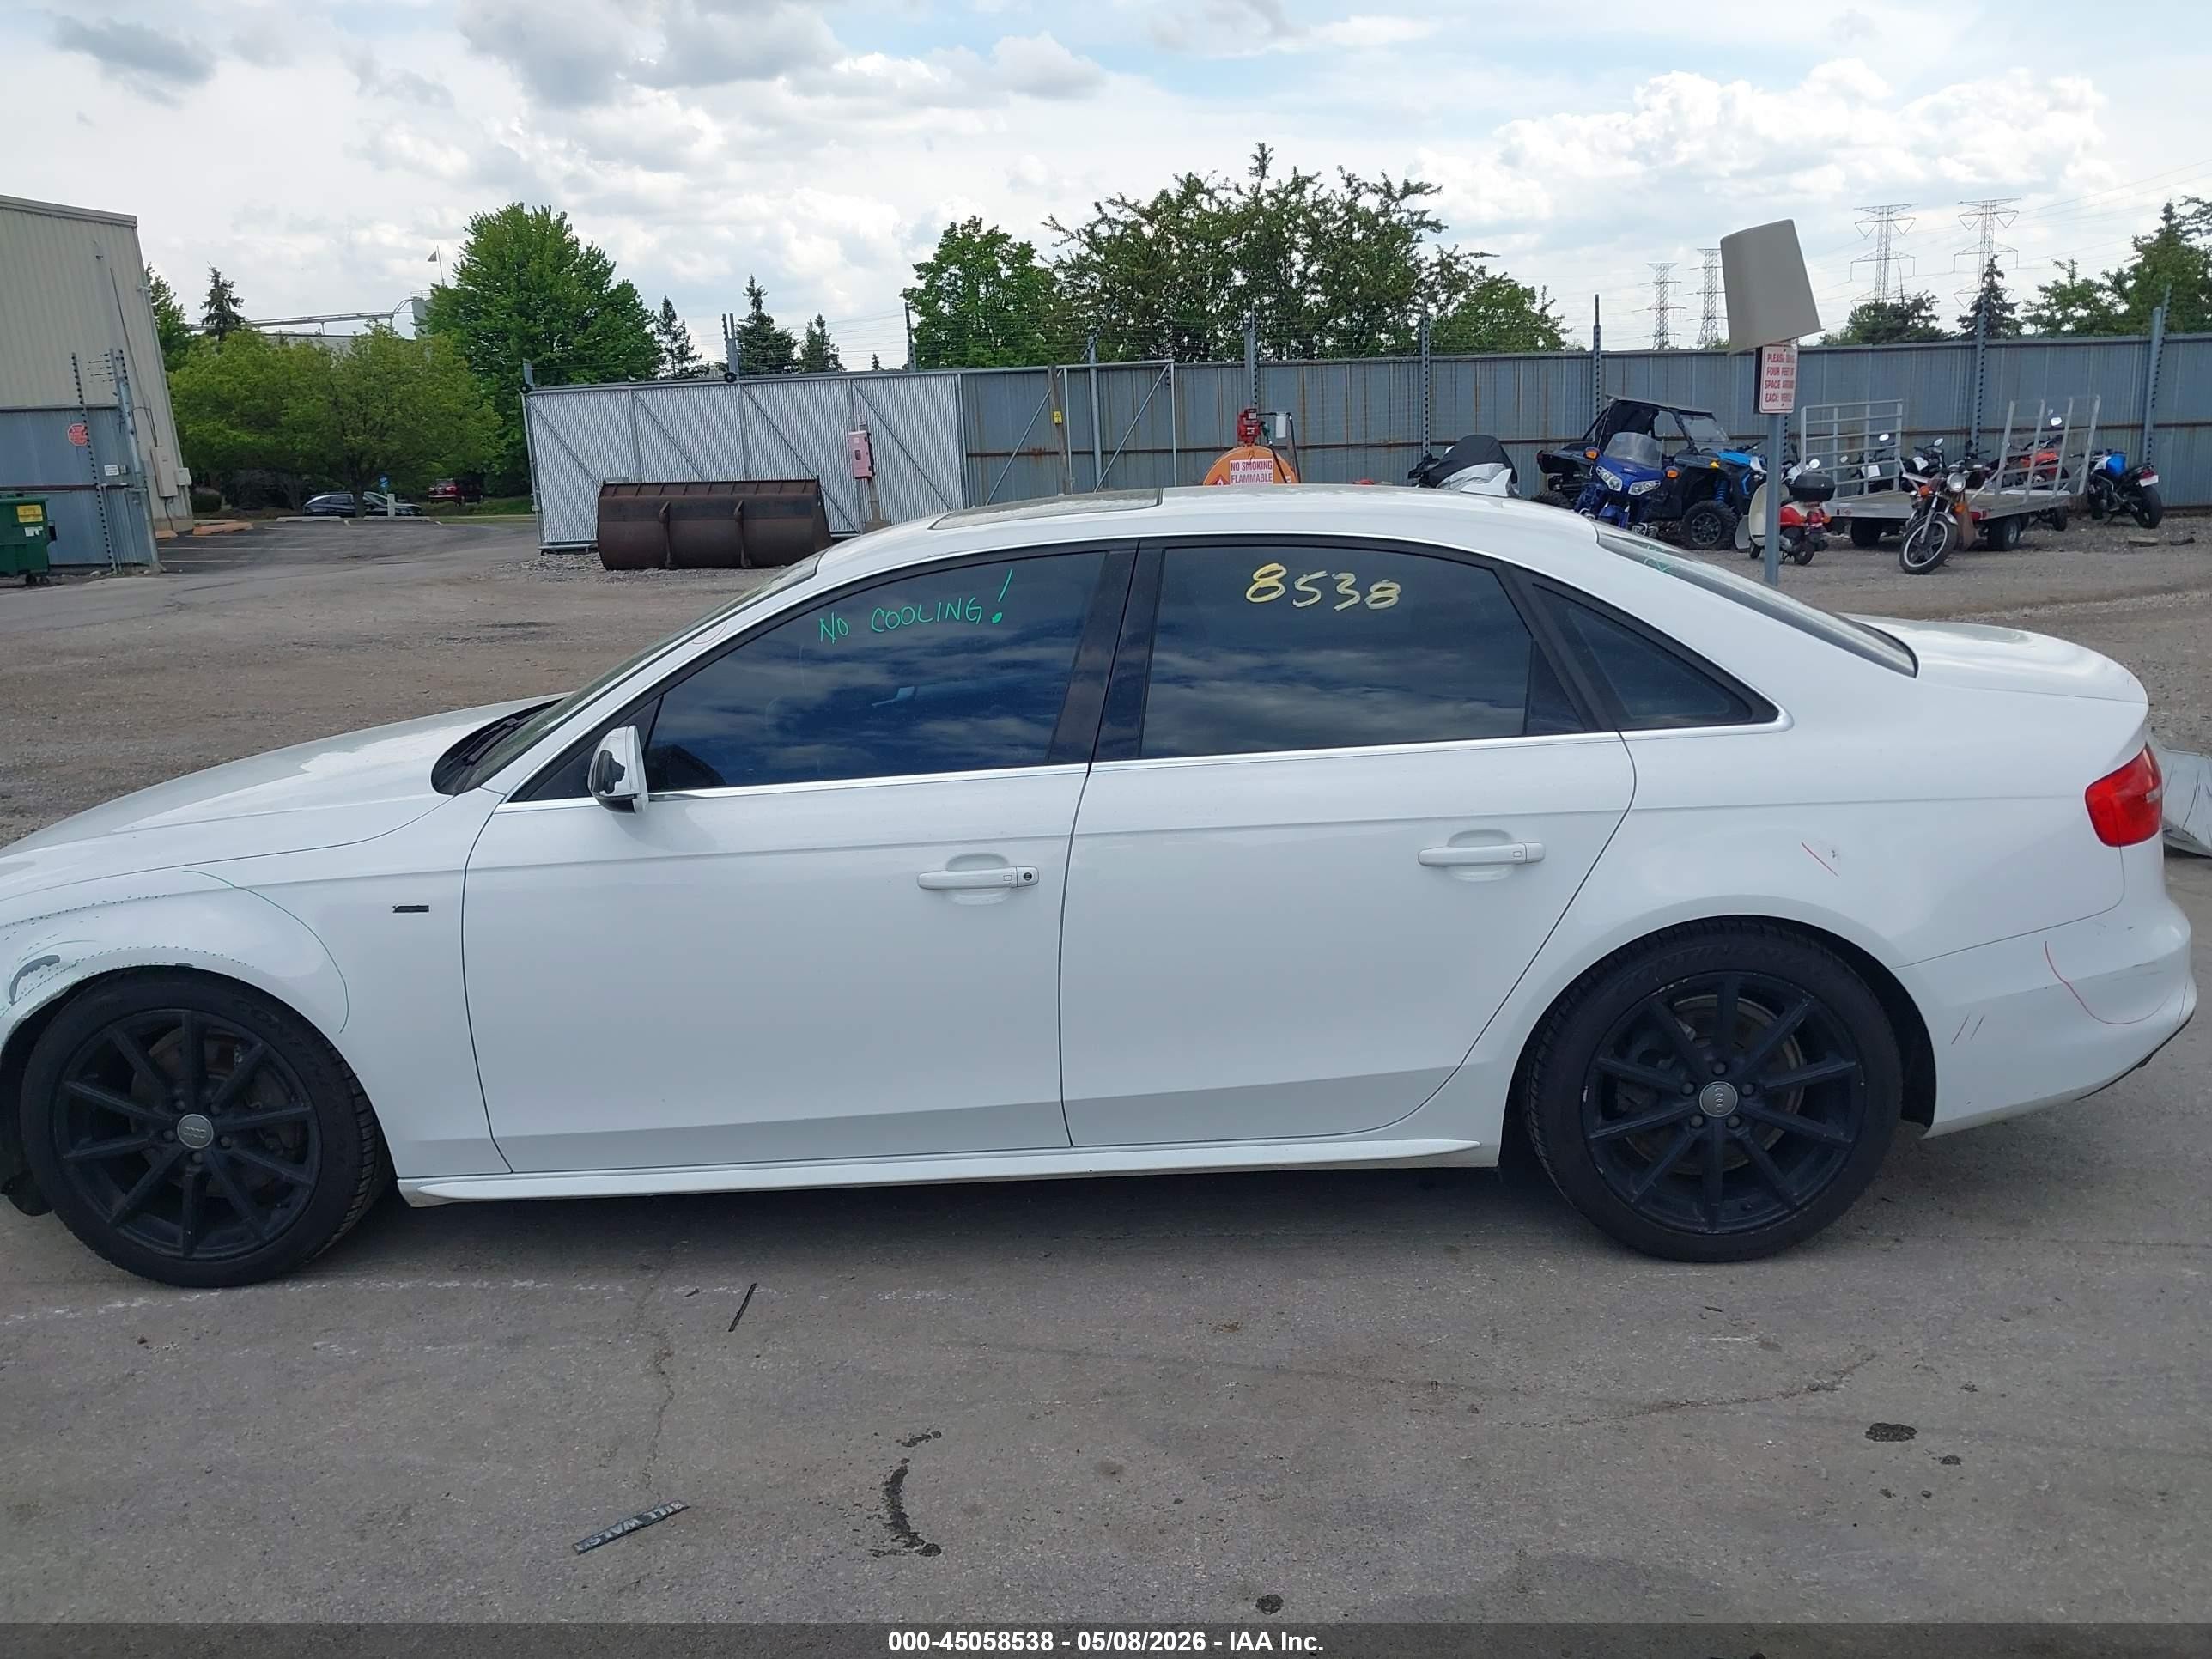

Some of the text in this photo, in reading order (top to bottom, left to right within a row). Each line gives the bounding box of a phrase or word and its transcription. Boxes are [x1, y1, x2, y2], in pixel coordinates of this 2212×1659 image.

[1765, 380, 1781, 389] SPACE
[1231, 460, 1273, 471] NO SMOKING
[1231, 472, 1273, 484] FLAMMABLE
[1246, 563, 1401, 611] 8538
[820, 611, 849, 644] NO
